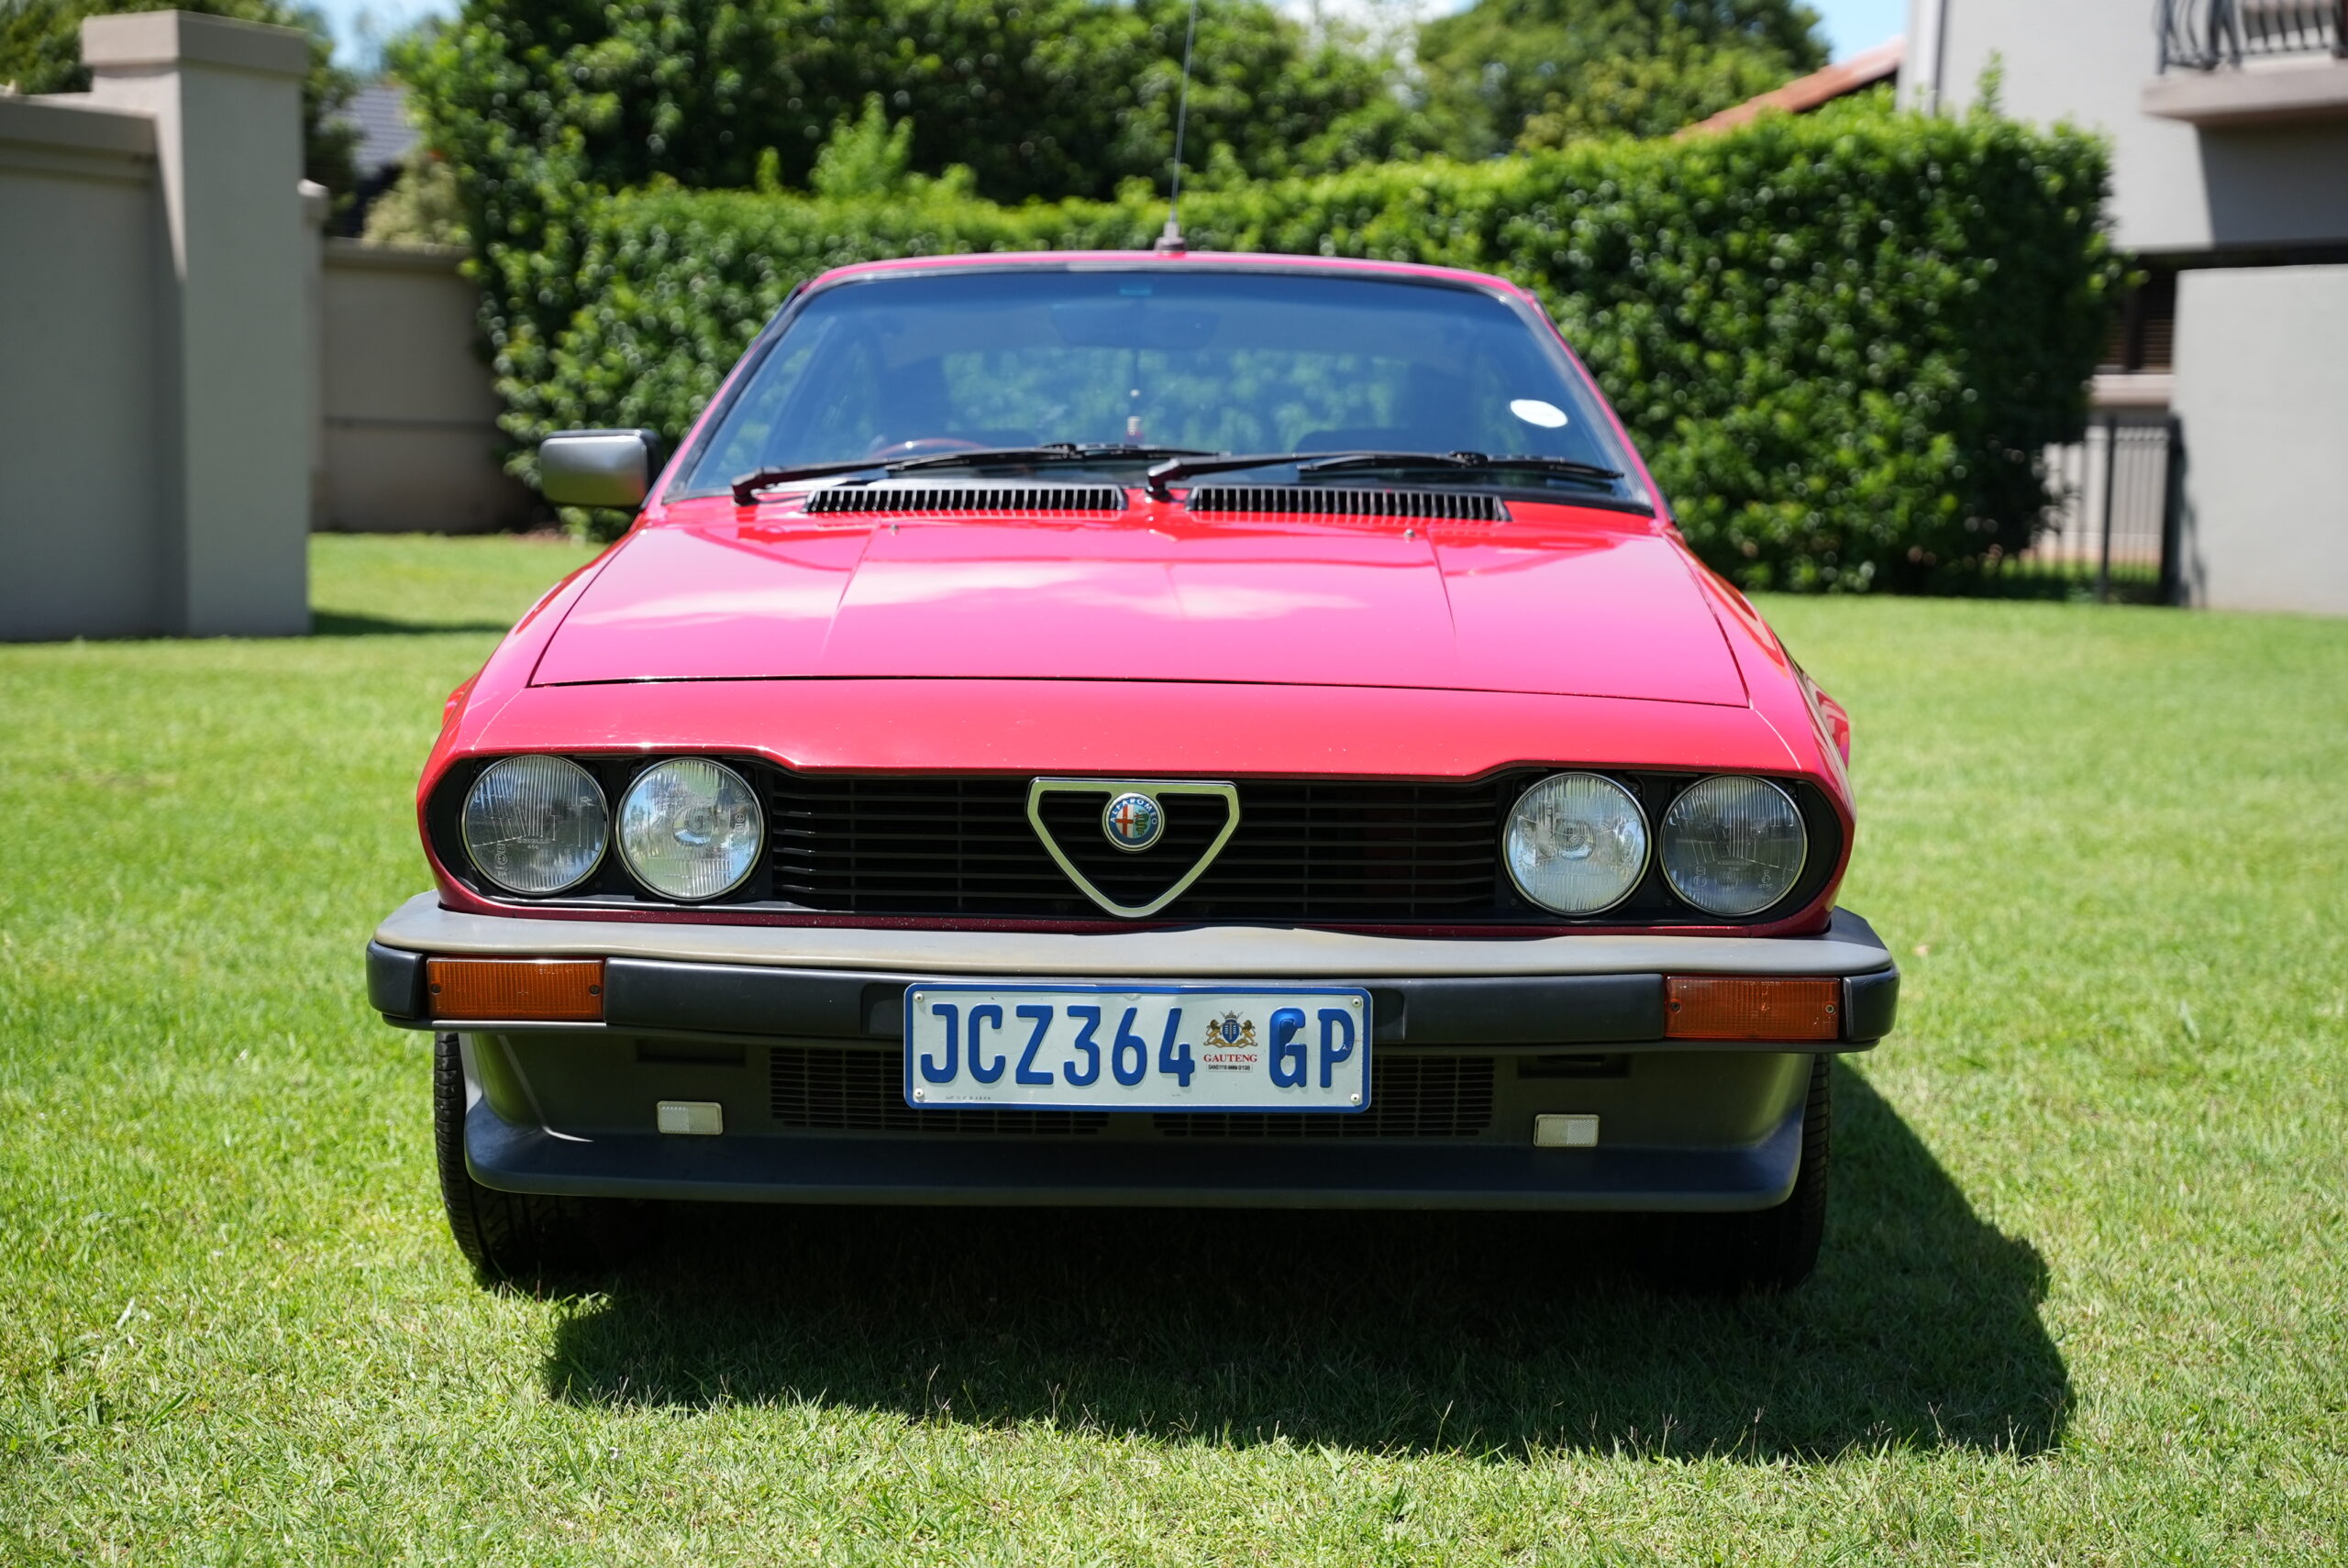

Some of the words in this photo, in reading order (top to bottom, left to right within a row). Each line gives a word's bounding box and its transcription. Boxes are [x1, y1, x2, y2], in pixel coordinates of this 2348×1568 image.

[920, 1003, 1195, 1088] JCZ364
[1268, 1007, 1355, 1088] GP
[1202, 1054, 1257, 1062] GAUTENG
